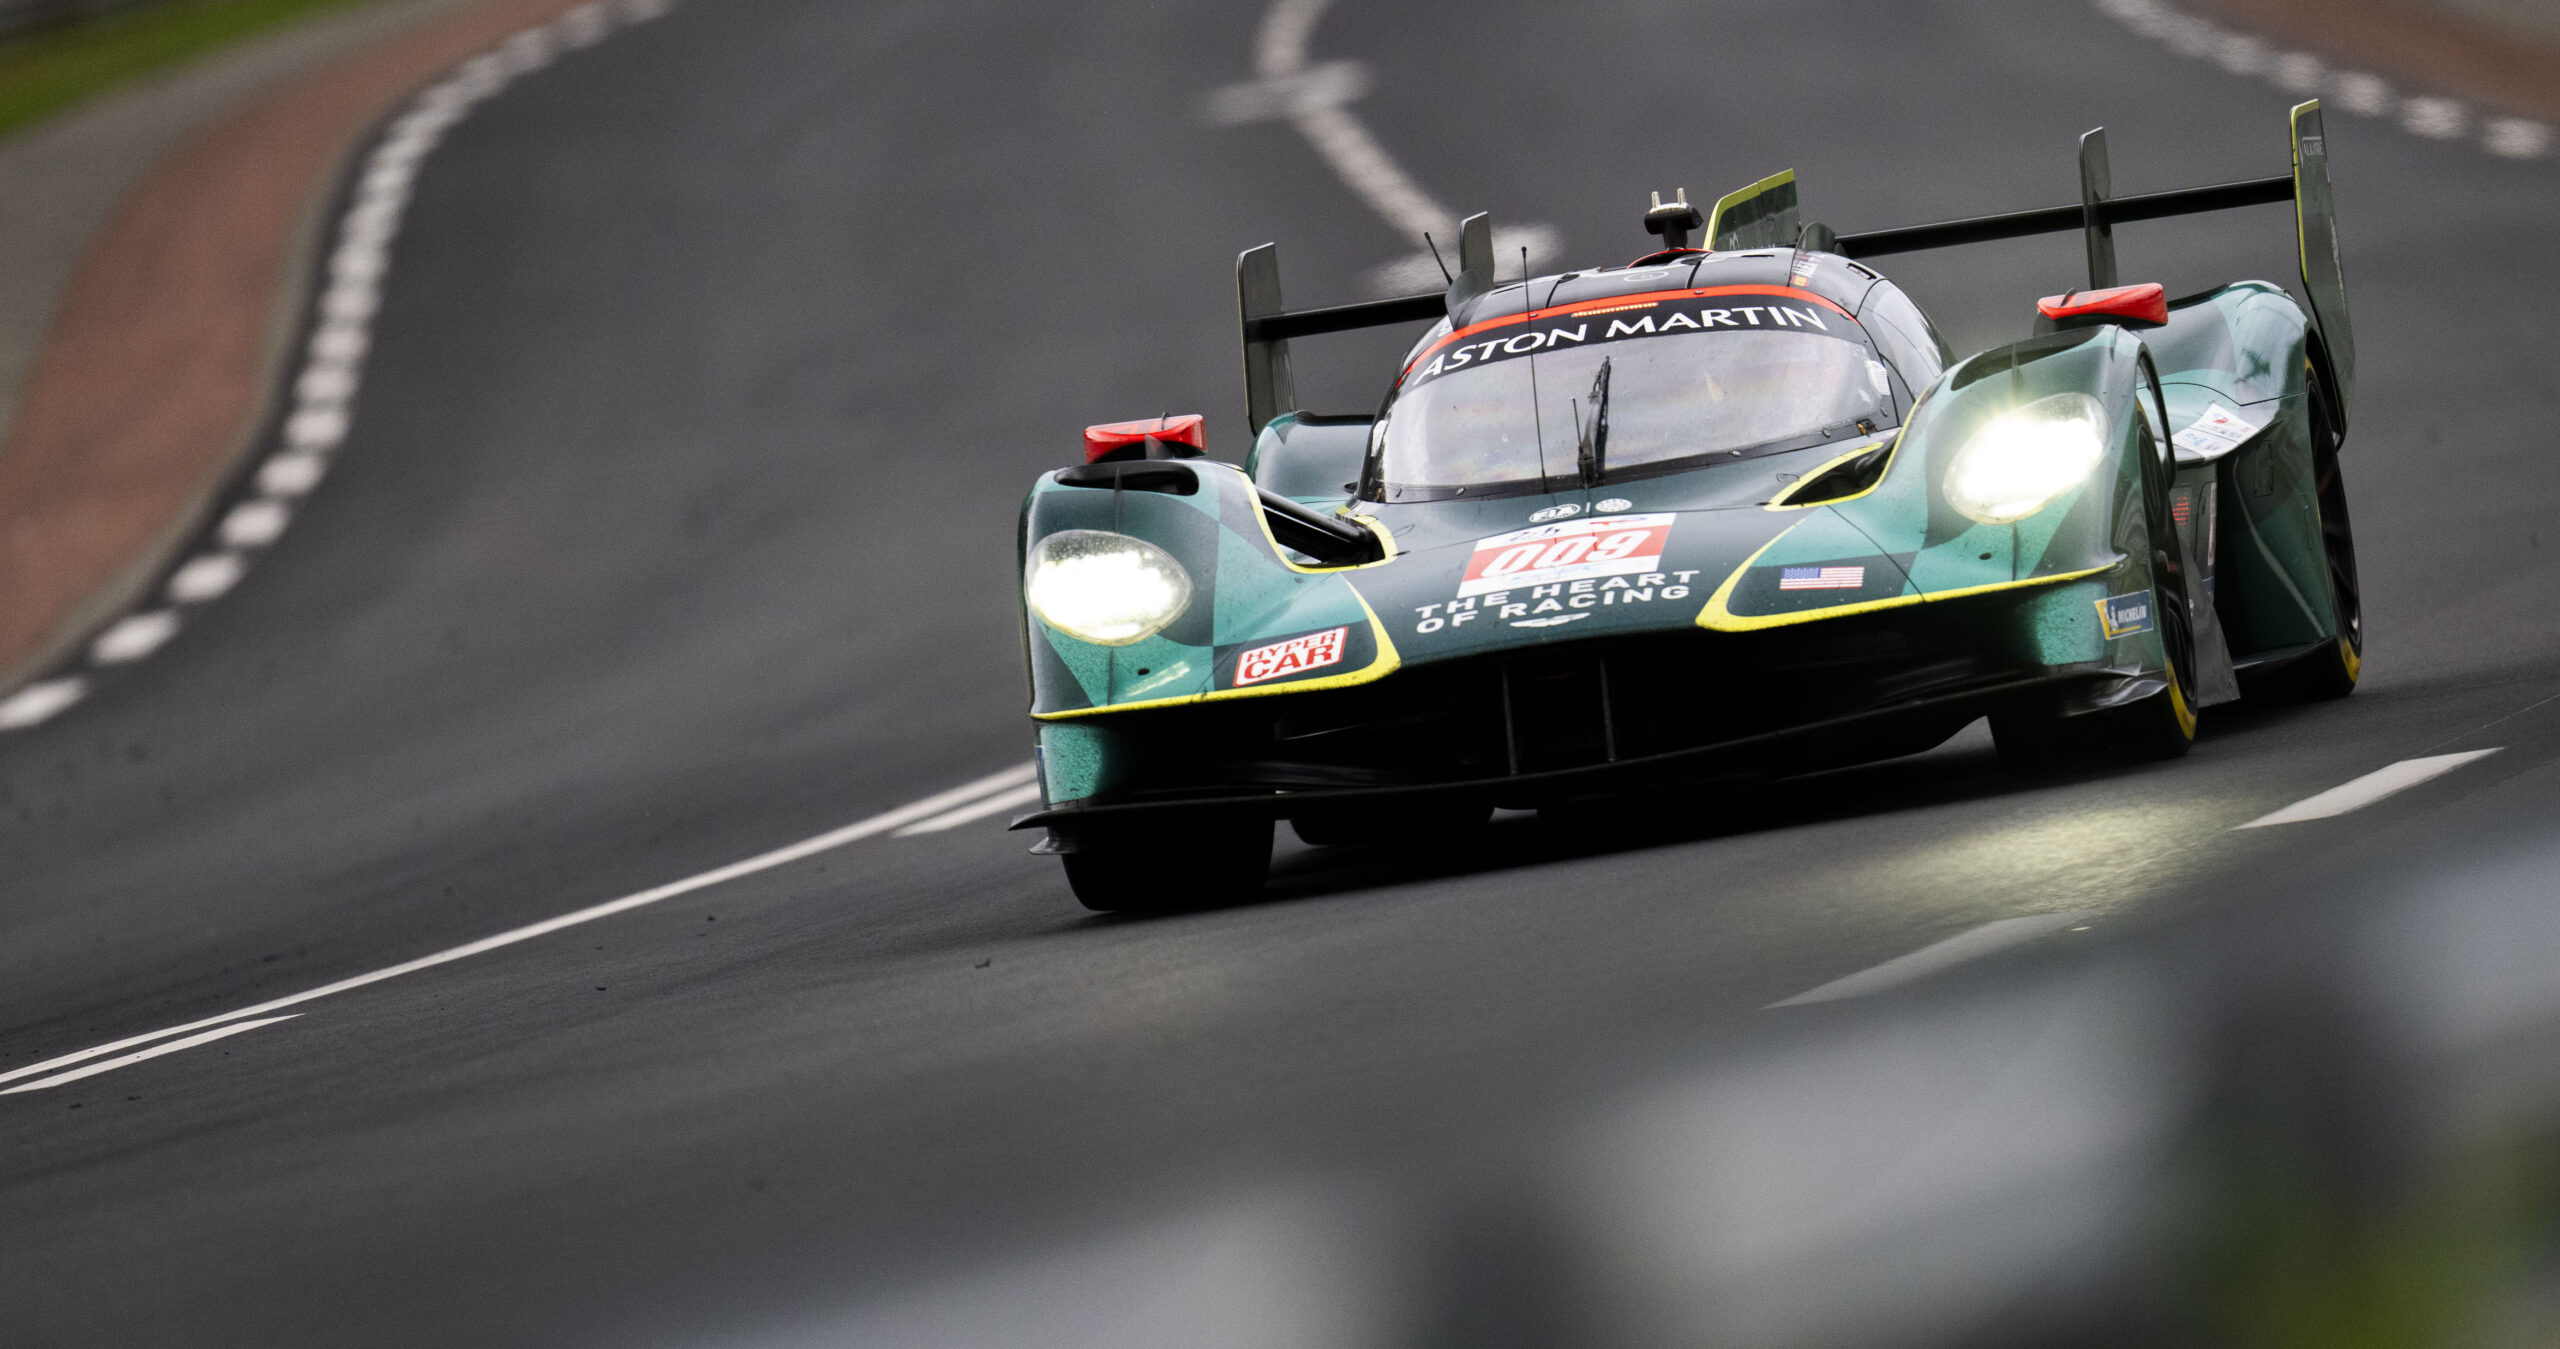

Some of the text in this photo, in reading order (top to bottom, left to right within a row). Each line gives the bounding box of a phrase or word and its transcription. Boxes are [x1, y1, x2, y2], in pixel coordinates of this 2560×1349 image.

[1413, 307, 1828, 385] ASTON MARTIN
[1531, 505, 1577, 521] FIA
[1481, 530, 1652, 577] 009
[1415, 591, 1510, 619] THE
[1532, 570, 1699, 599] HEART
[1416, 585, 1690, 633] OF RACING
[2117, 603, 2147, 624] MICHELIN
[1244, 644, 1333, 679] CAR
[1247, 633, 1336, 662] HYPER
